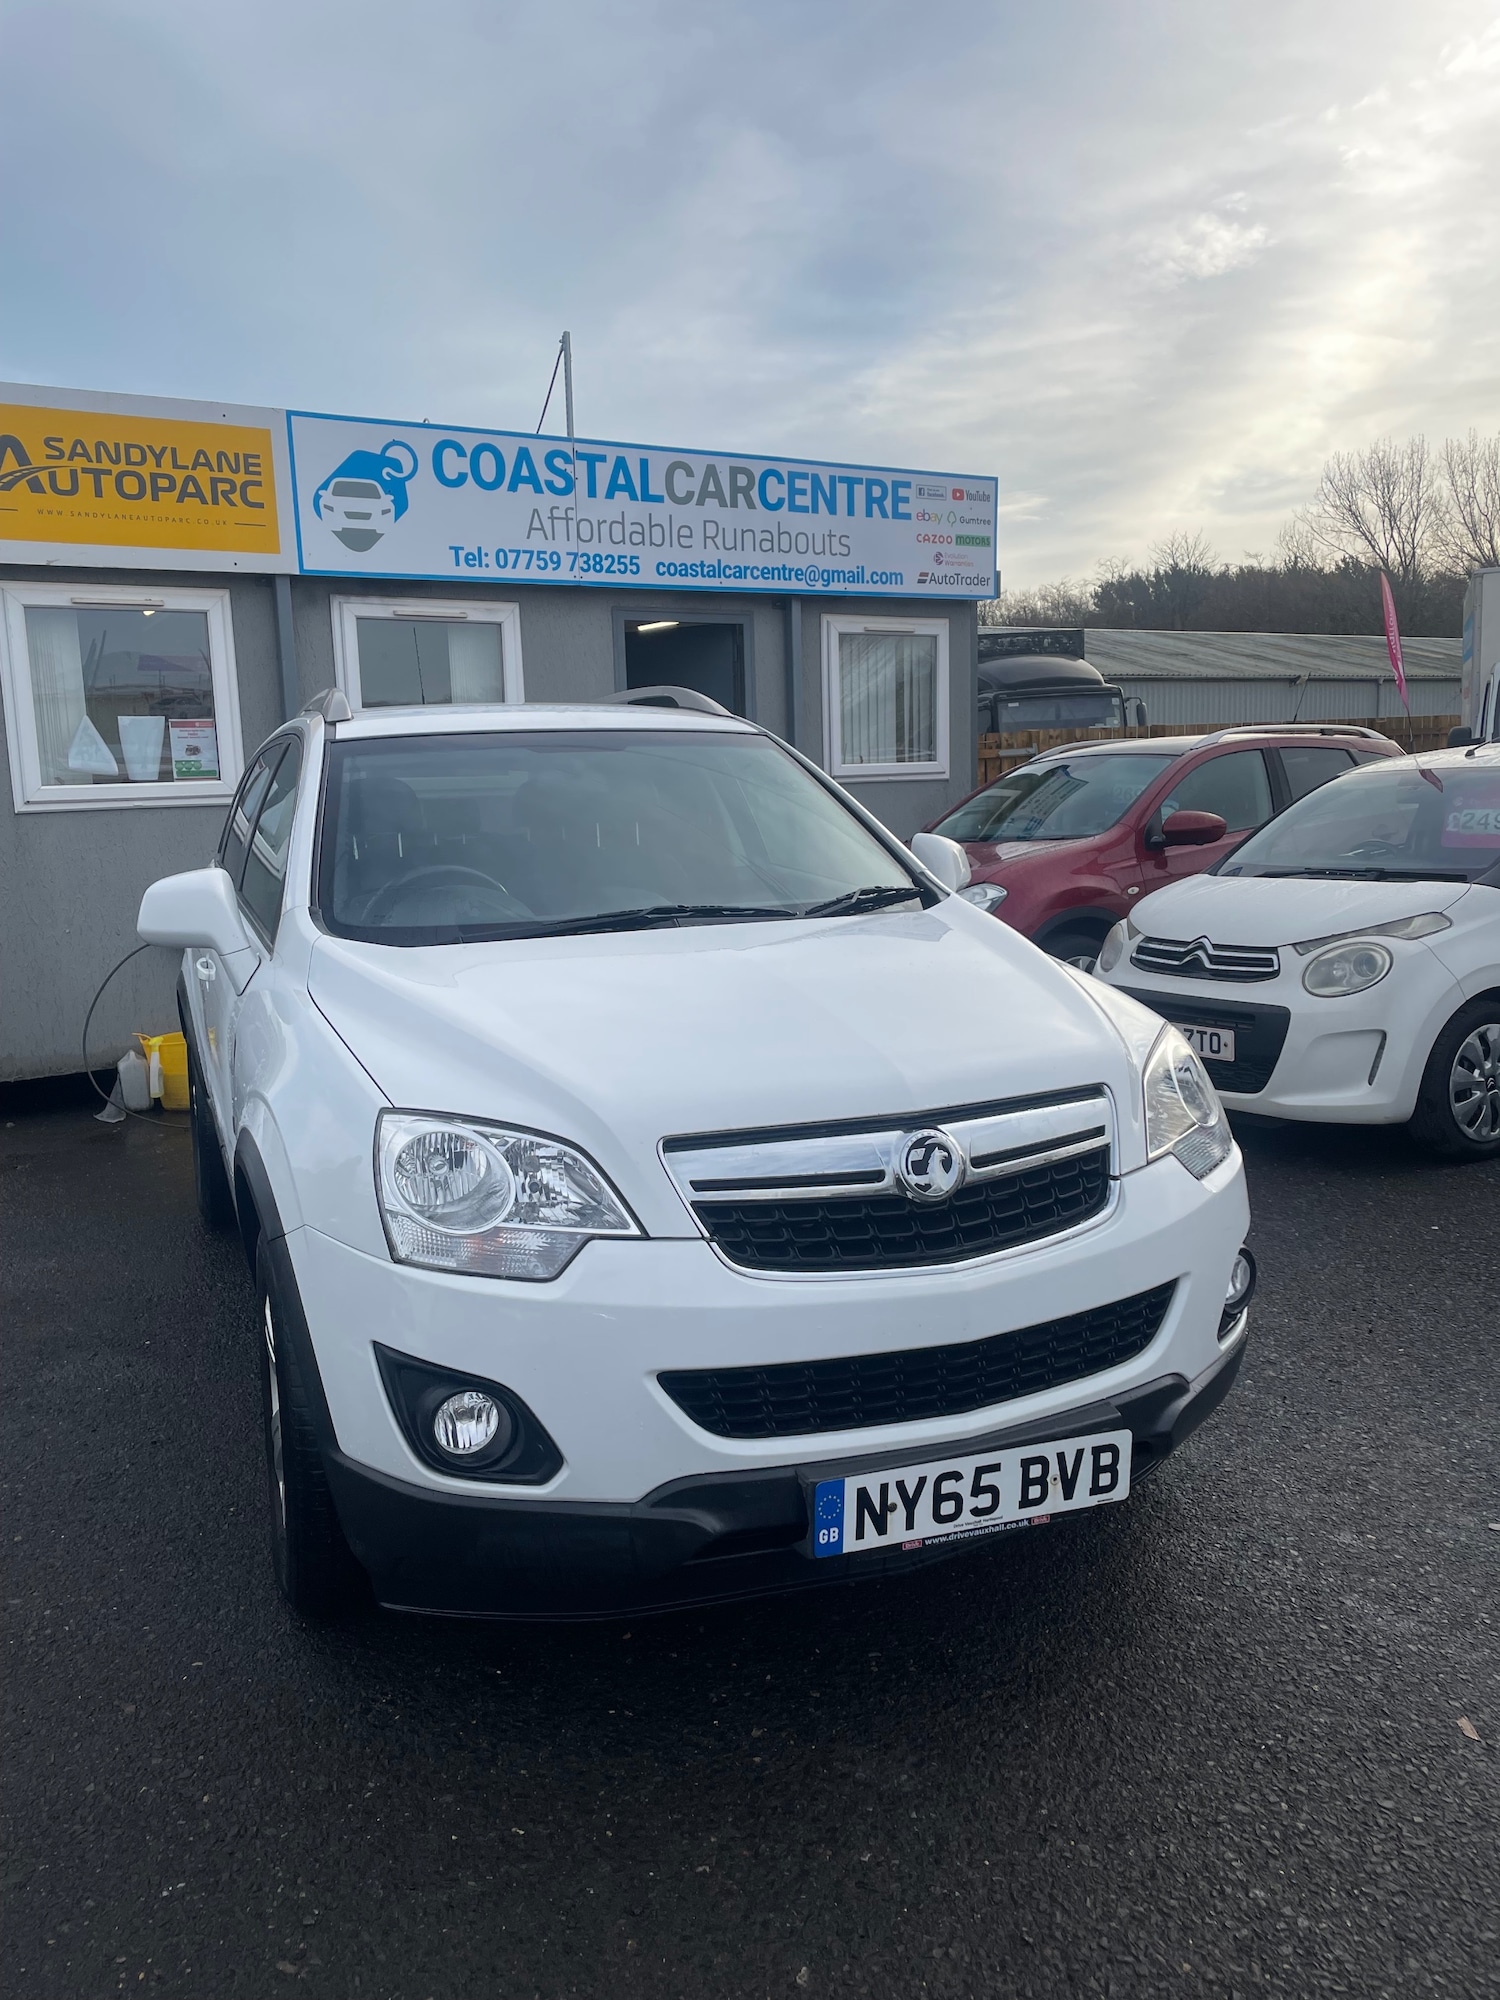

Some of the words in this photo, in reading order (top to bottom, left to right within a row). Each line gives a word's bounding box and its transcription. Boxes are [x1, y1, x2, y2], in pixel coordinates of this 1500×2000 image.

[43, 436, 262, 476] SANDYLANE
[965, 490, 991, 503] YouTube
[37, 508, 228, 526] WWW.SANDYLANEAUTOPARC.CO.UK
[916, 508, 943, 525] ebay
[959, 516, 991, 526] Gumtree
[526, 506, 694, 549] Affordable
[703, 518, 851, 557] Runabouts
[916, 533, 953, 545] CAZOO
[449, 545, 490, 568] Tel:
[495, 548, 561, 572] 07759
[565, 551, 641, 575] 738255
[655, 558, 904, 588] coastalcarcentre@gmail.com
[929, 572, 991, 587] AutoTrader
[854, 1462, 1002, 1542] NY65
[1018, 1443, 1121, 1510] BVB
[818, 1526, 839, 1545] GB
[925, 1518, 1030, 1546] www.drivevauxhall.co.uk
